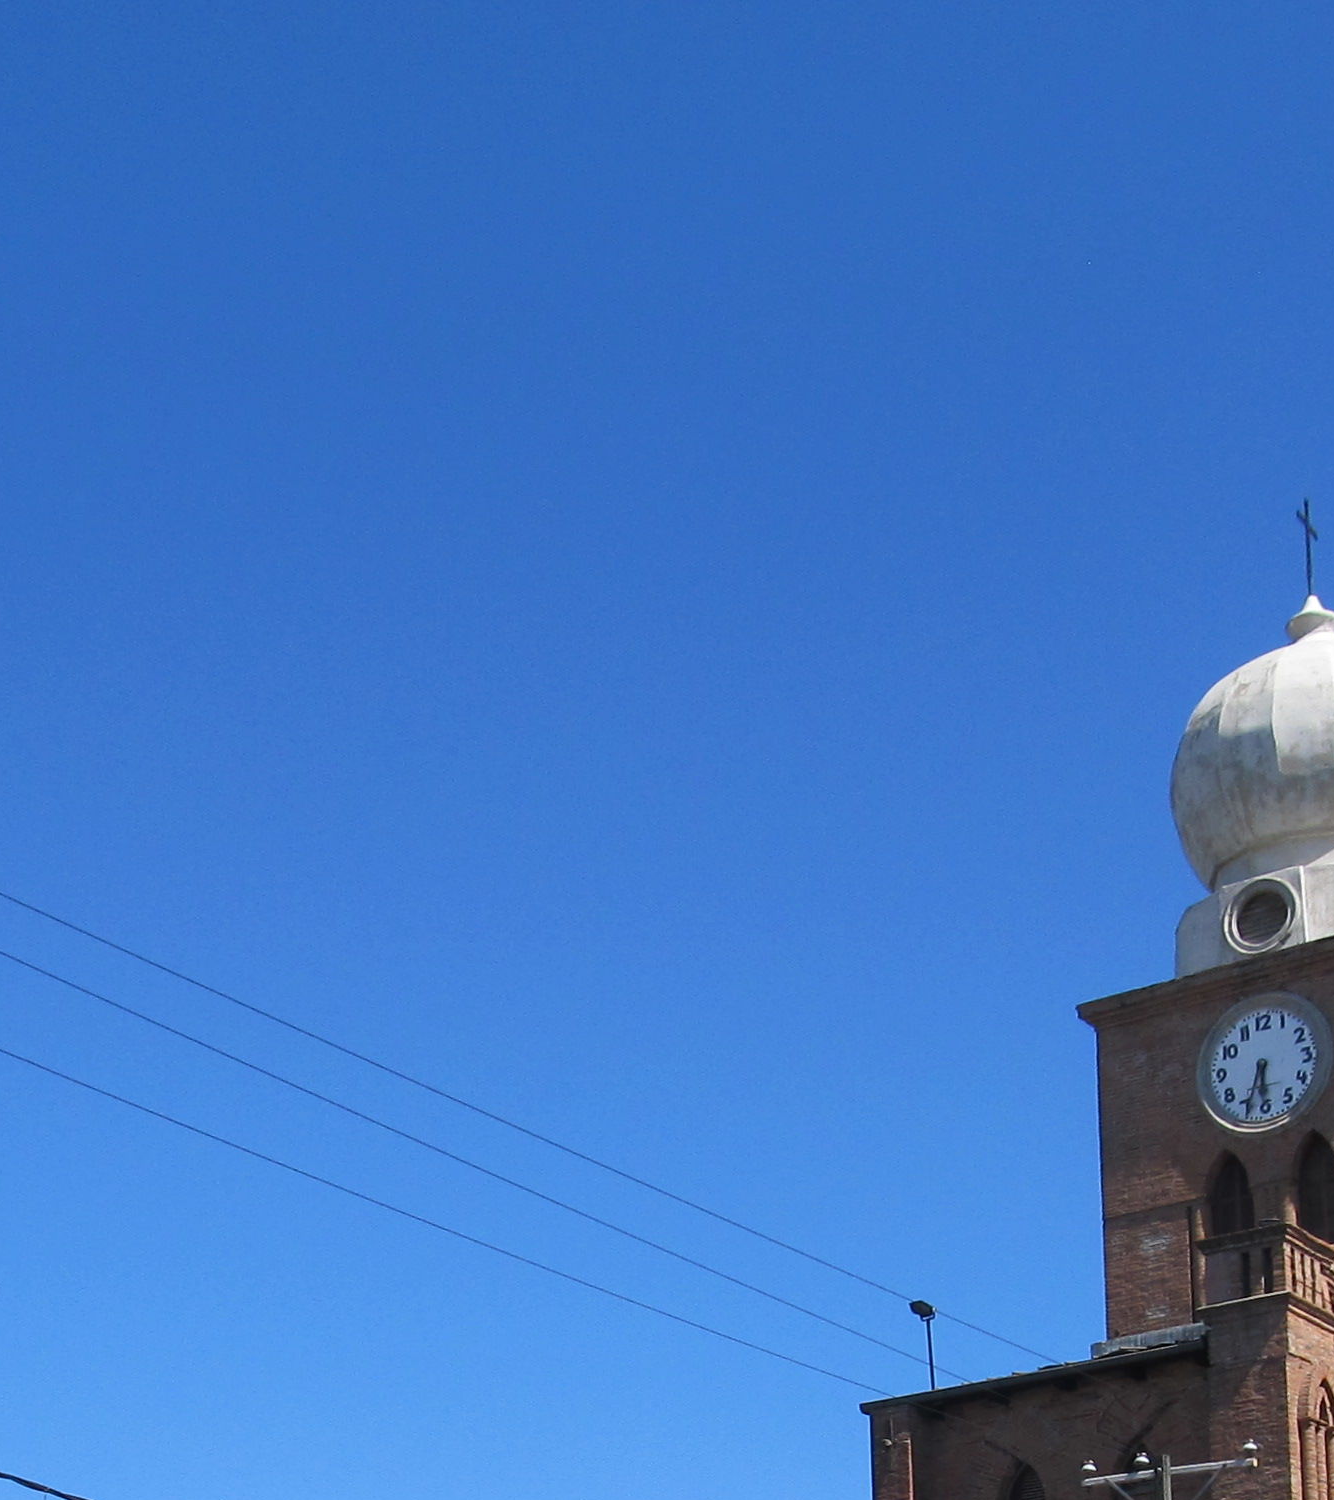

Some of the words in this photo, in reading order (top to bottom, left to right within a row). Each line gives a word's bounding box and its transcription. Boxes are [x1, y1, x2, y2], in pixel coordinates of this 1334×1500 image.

[1255, 1014, 1272, 1031] 12
[1279, 1014, 1285, 1029] 1
[1240, 1025, 1250, 1042] 11
[1293, 1027, 1306, 1044] 2
[1222, 1043, 1238, 1060] 10
[1300, 1046, 1313, 1063] 3
[1216, 1068, 1227, 1083] 9
[1296, 1070, 1307, 1085] 4
[1224, 1087, 1236, 1103] 8
[1283, 1087, 1293, 1104] 5
[1260, 1099, 1272, 1114] 6
